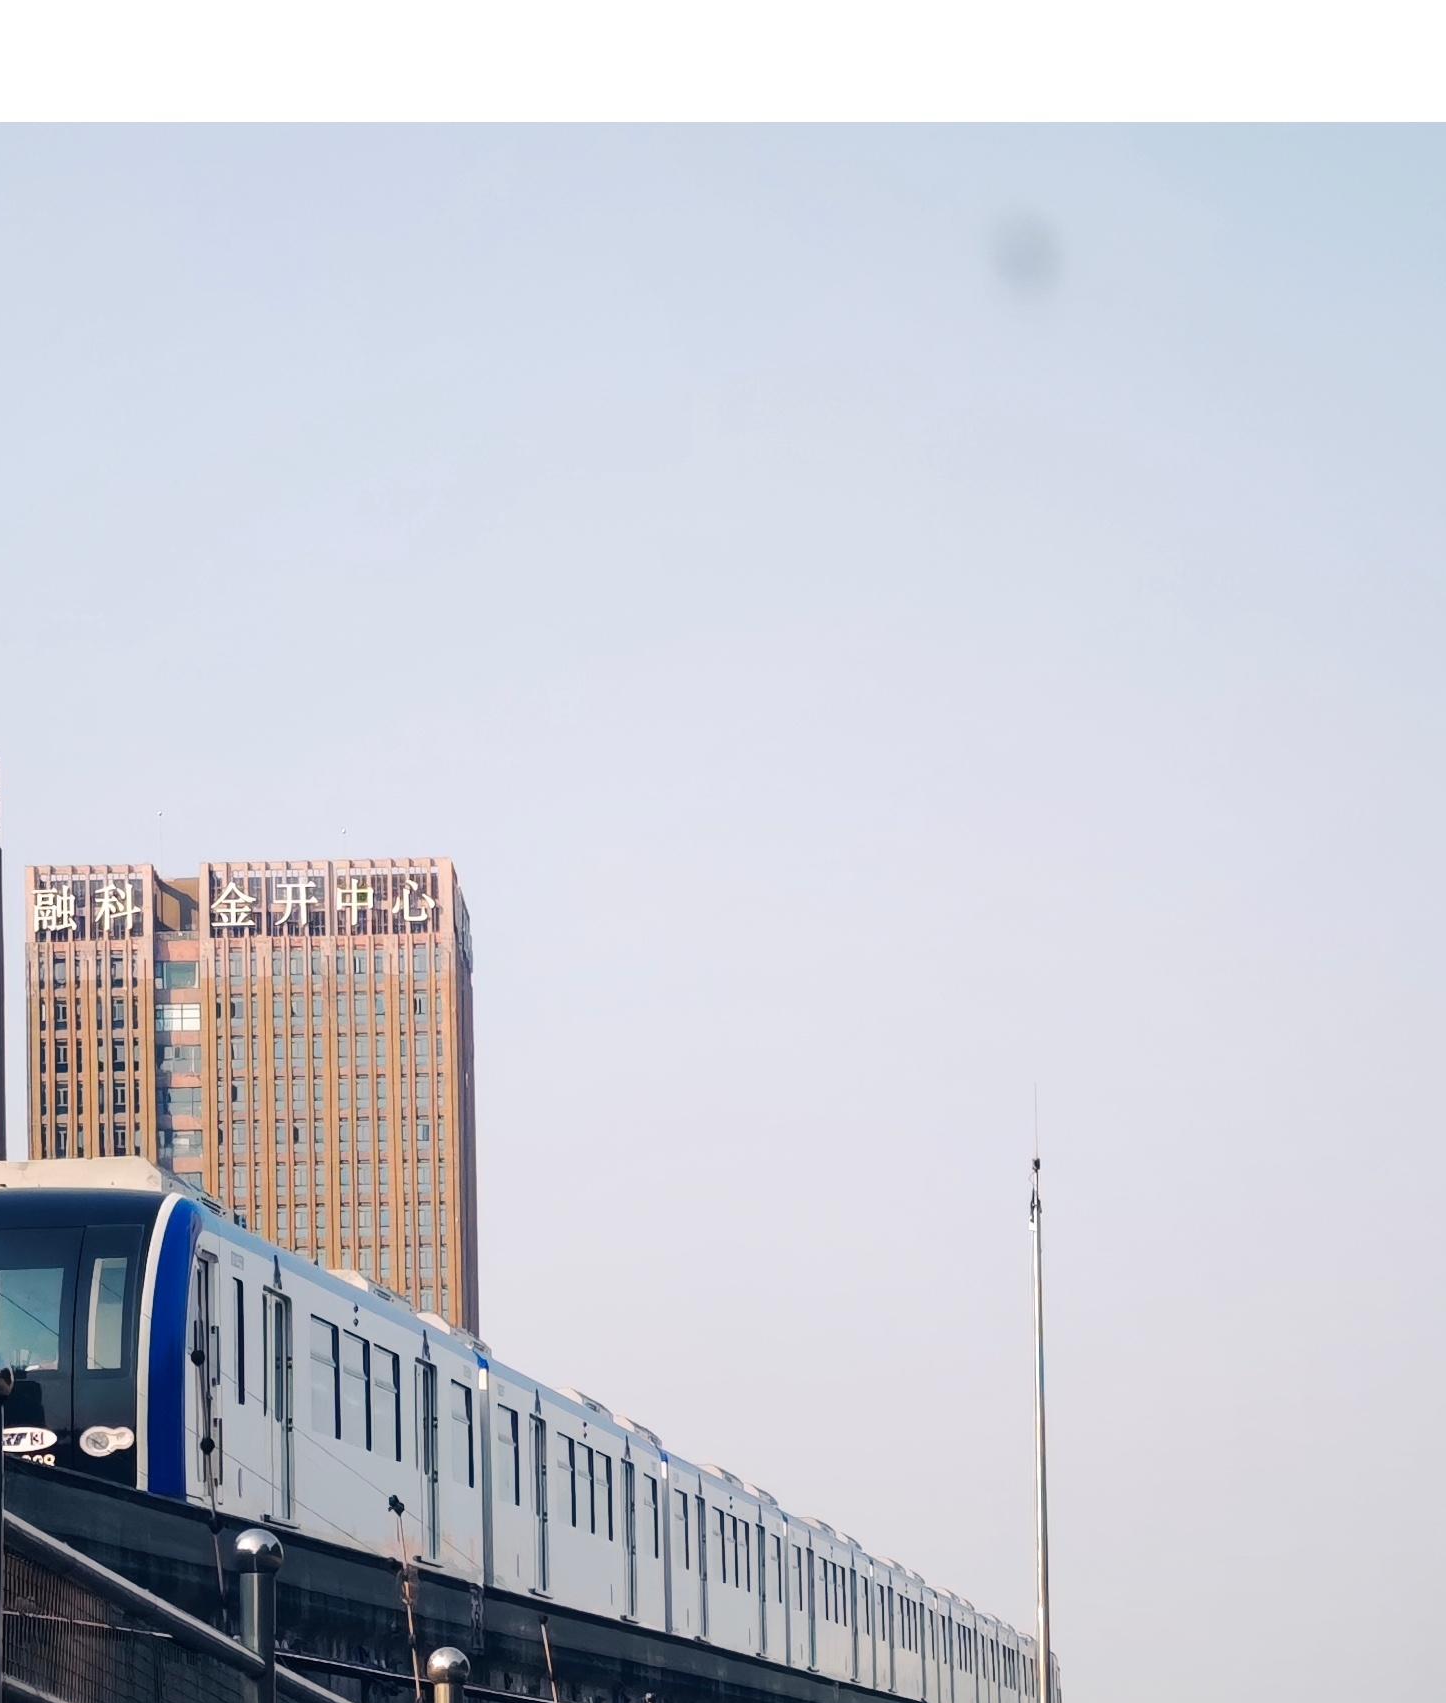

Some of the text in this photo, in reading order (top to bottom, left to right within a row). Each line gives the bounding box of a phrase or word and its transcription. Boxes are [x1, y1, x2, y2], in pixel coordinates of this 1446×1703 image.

[32, 877, 437, 932] 融科 金开中心
